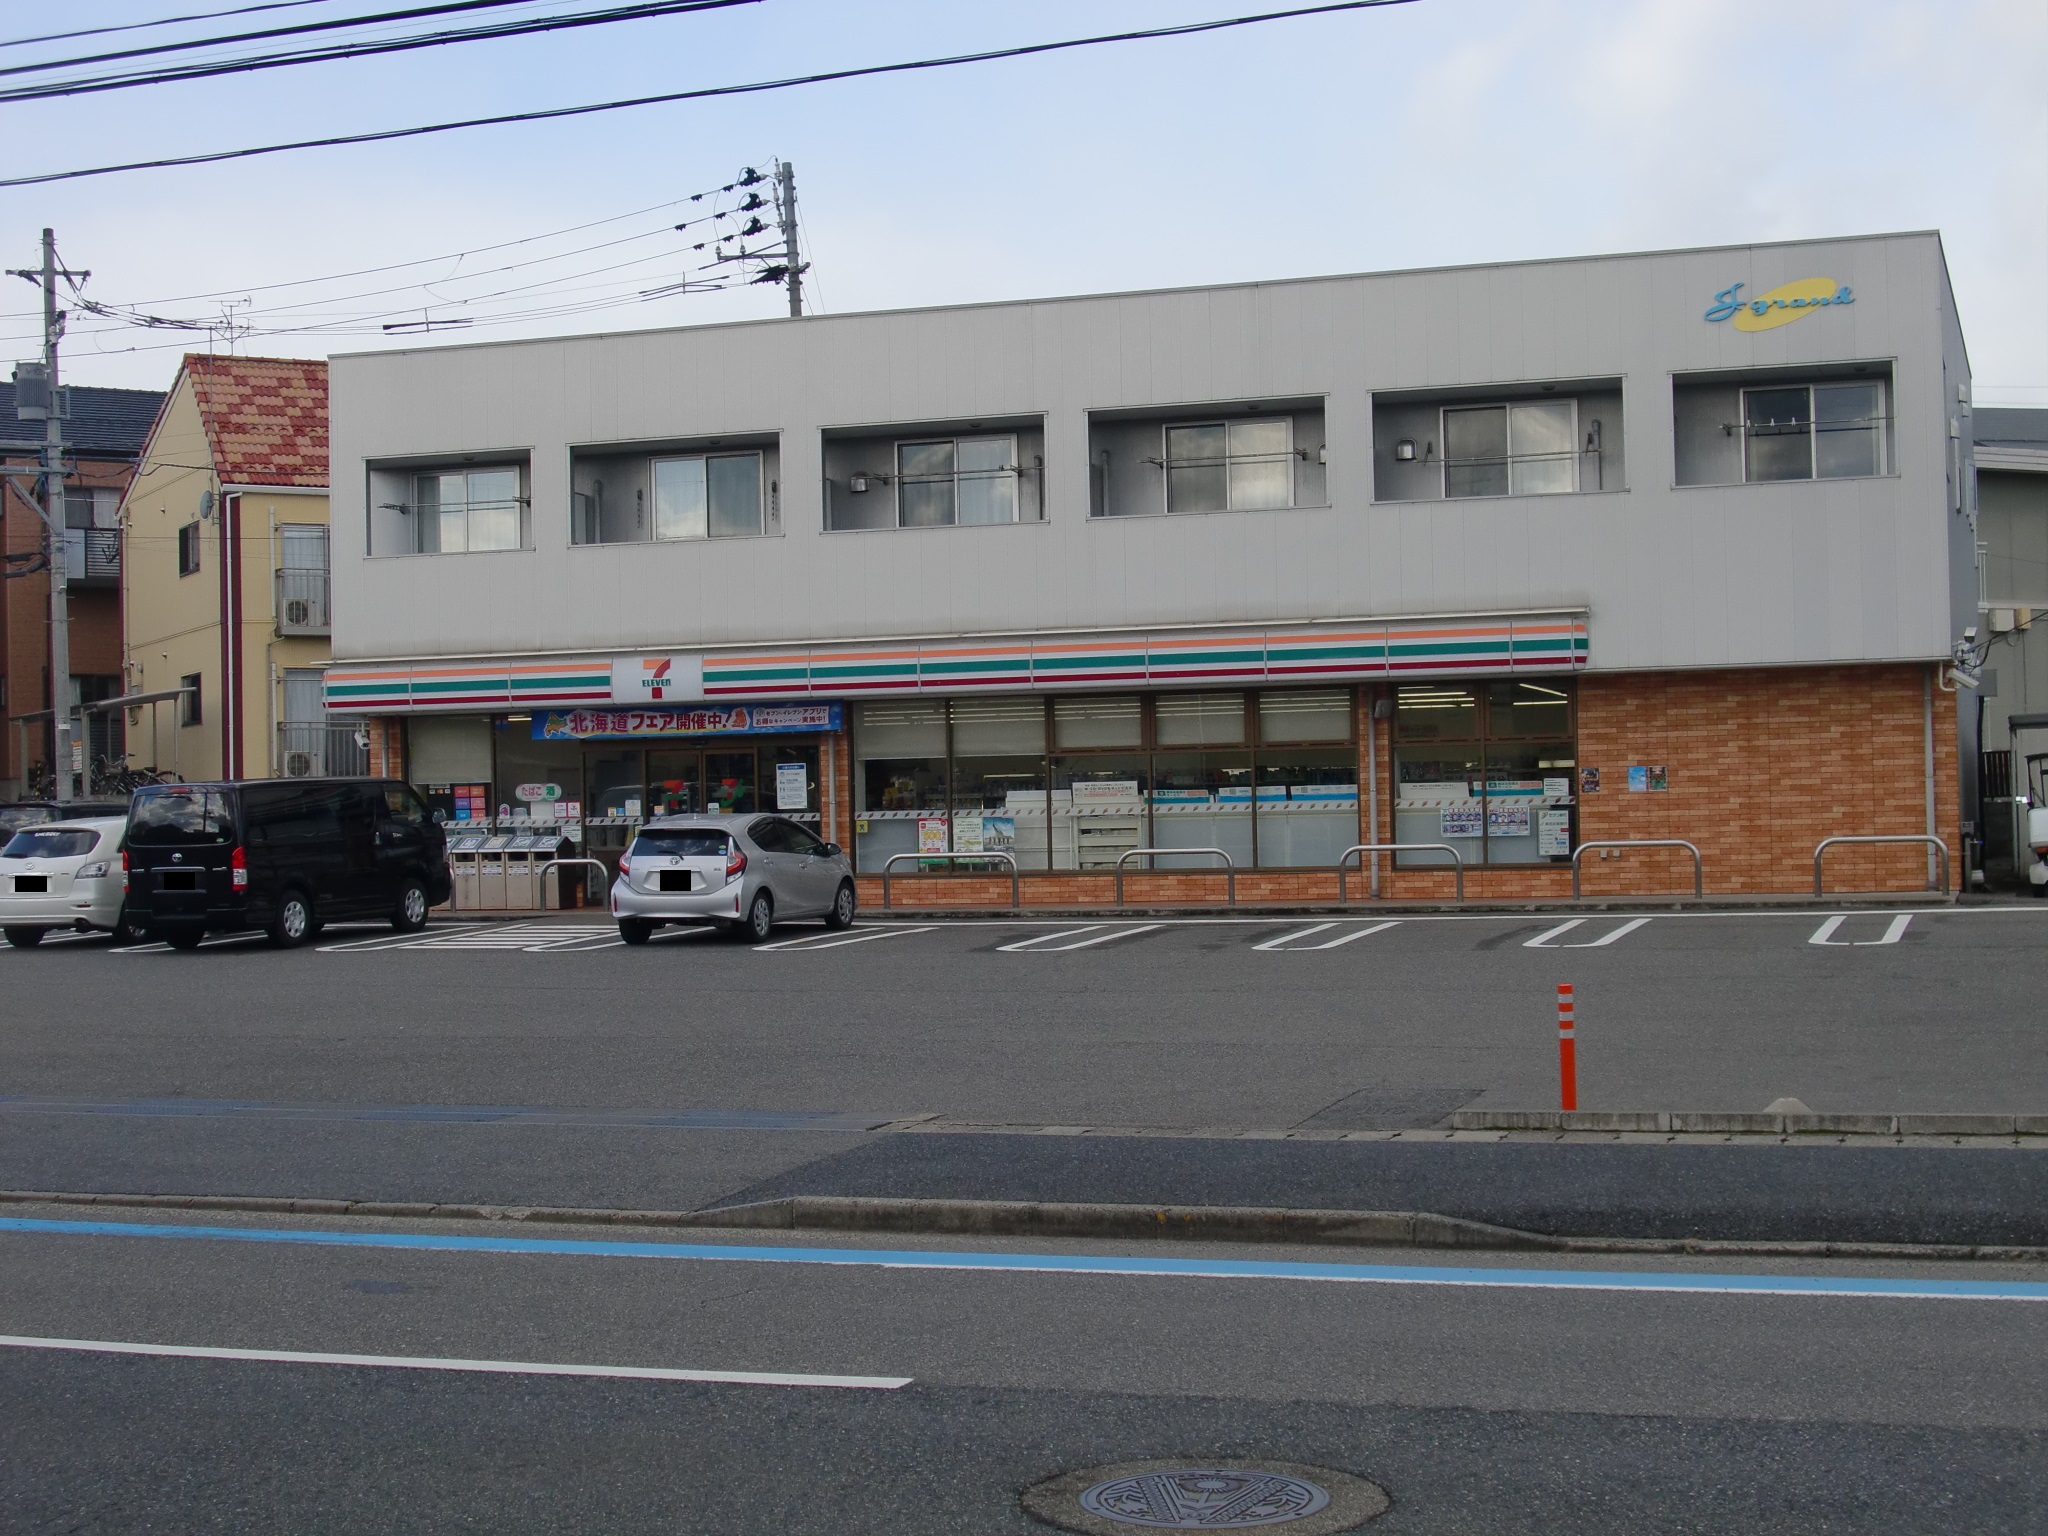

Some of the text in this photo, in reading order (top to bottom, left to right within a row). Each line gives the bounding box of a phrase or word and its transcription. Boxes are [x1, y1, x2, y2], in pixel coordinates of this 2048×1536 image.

[642, 658, 671, 699] 7
[570, 711, 733, 733] 北海道フェア開催中!
[522, 786, 542, 797] たばこ
